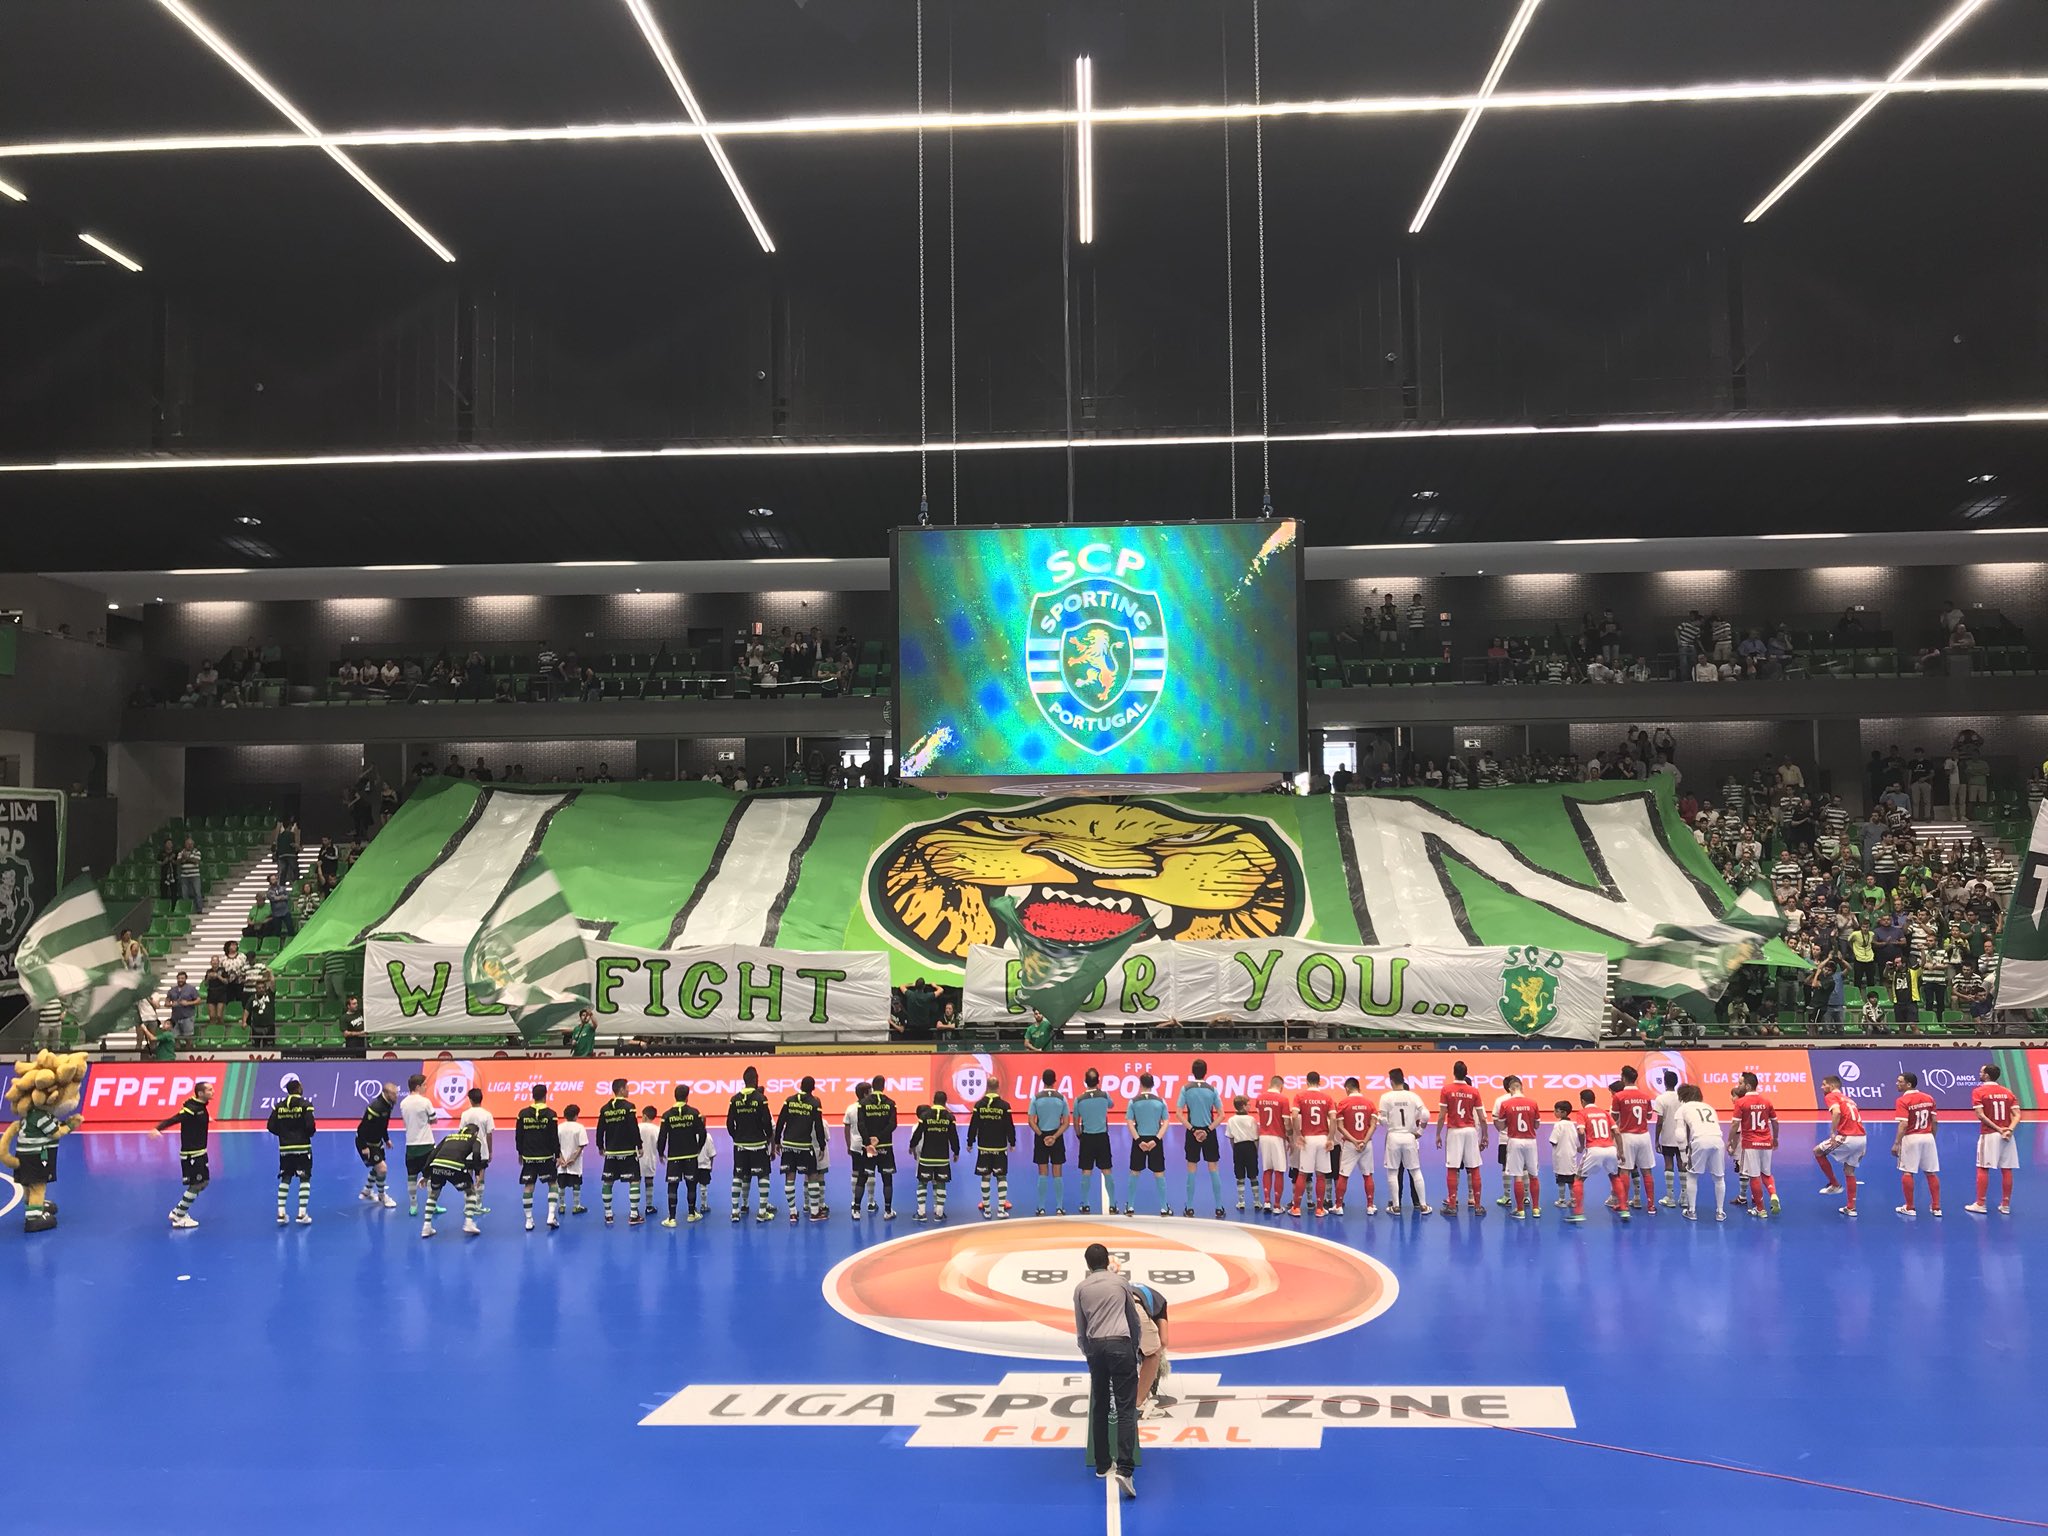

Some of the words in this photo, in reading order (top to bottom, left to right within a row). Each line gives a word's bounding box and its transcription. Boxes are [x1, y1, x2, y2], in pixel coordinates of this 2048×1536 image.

[1046, 543, 1145, 583] SCP
[1040, 590, 1152, 634] SPORTING
[1048, 700, 1148, 732] PORTUGAL
[1504, 946, 1564, 968] SCP
[595, 956, 847, 1024] FIGHT
[1125, 1062, 1153, 1072] FPF
[487, 1082, 511, 1092] LIGA
[553, 1081, 584, 1092] ZONE
[1703, 1072, 1729, 1083] LIGA
[1774, 1072, 1807, 1083] ZONE
[1264, 1107, 1273, 1126] 7
[1310, 1106, 1321, 1125] 5
[1399, 1108, 1406, 1127] 1
[1457, 1099, 1466, 1118] 4
[1632, 1105, 1643, 1125] 9
[1696, 1108, 1715, 1123] 12
[1992, 1101, 2005, 1121] 11
[1354, 1112, 1365, 1131] 8
[1517, 1113, 1528, 1132] 6
[1591, 1119, 1609, 1138] 10
[1751, 1111, 1766, 1131] 14
[1914, 1110, 1929, 1130] 18
[708, 1393, 895, 1417] LIGA
[1261, 1394, 1510, 1419] ZONE
[983, 1426, 1252, 1443] FUSAL
